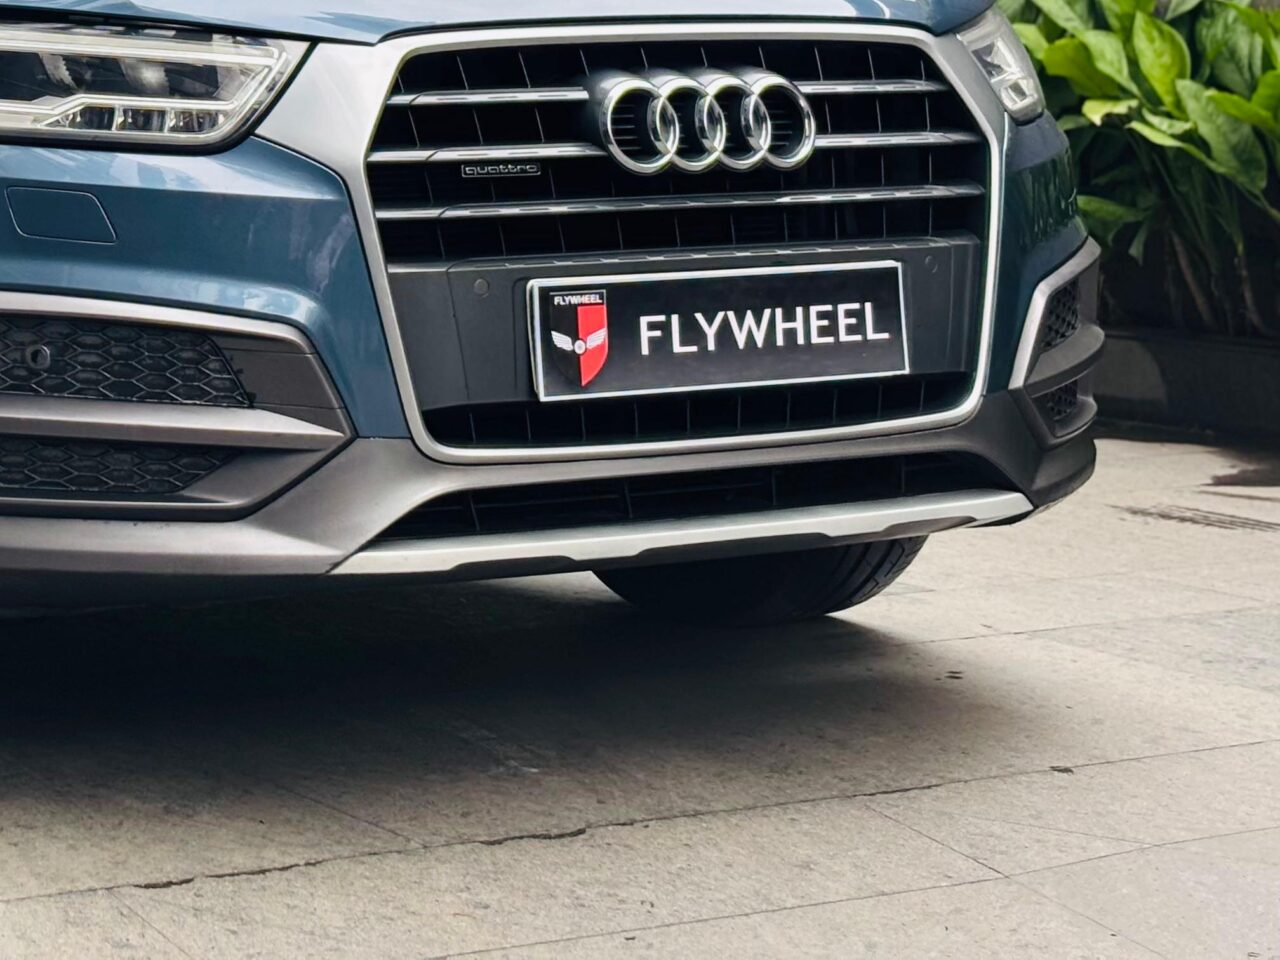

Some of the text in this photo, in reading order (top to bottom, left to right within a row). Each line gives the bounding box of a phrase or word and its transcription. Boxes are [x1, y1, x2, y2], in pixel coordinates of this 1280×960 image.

[464, 164, 537, 176] quattro
[553, 293, 603, 305] FLYWHEEL
[639, 302, 890, 356] FLYWHEEL
